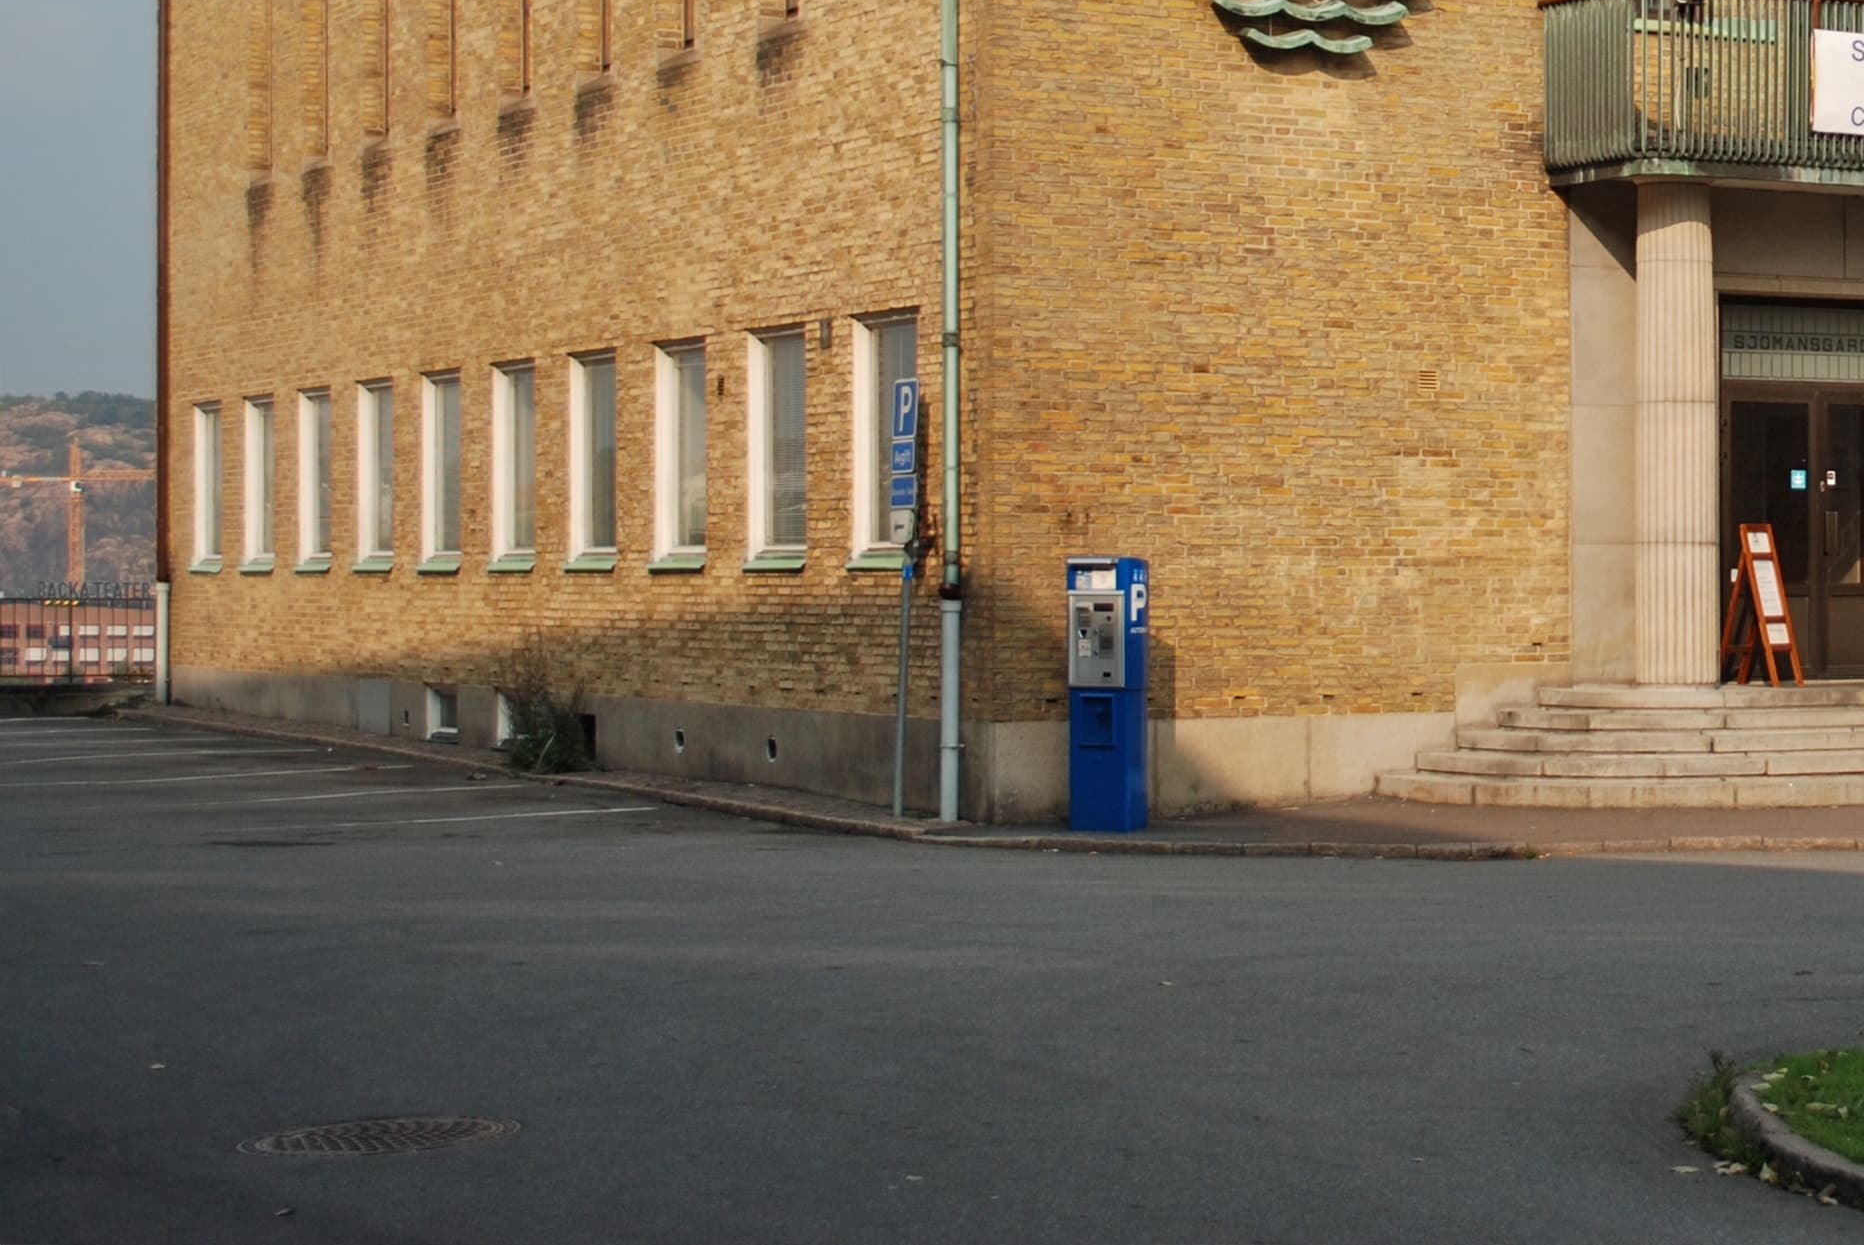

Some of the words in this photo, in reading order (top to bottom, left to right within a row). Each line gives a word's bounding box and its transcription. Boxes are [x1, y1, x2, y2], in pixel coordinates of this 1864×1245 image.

[899, 385, 913, 432] P
[38, 580, 89, 598] BACKA
[93, 581, 151, 598] TEATER
[1130, 583, 1148, 622] P
